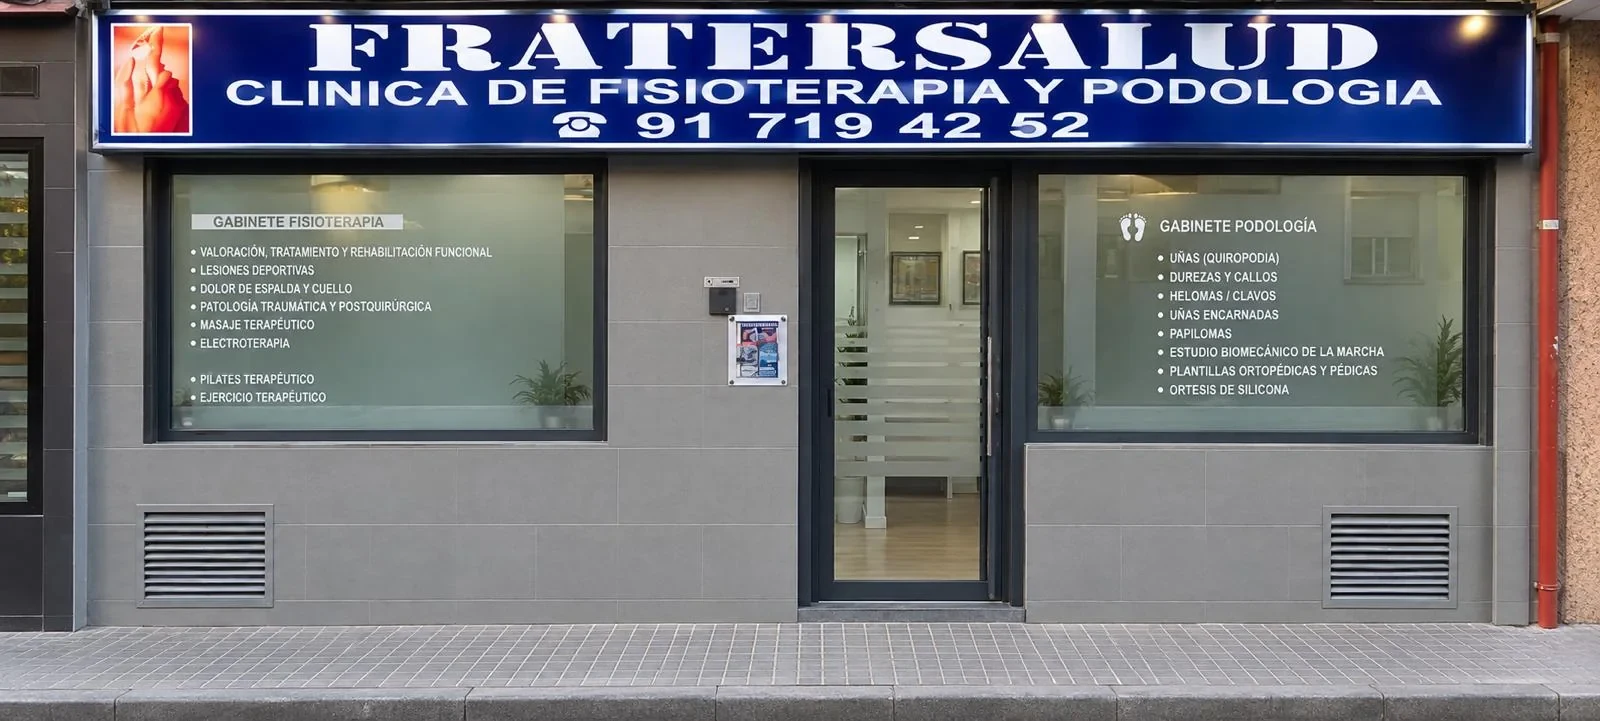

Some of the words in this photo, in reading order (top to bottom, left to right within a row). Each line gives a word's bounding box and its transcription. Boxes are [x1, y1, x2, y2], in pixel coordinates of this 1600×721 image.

[308, 22, 1379, 71] FRATERSALUD
[226, 79, 469, 107] CLINICA
[488, 78, 567, 106] DE
[590, 78, 1010, 105] FISIOTERAPIA
[1023, 78, 1064, 104] Y
[1083, 77, 1442, 106] PODOLOGIA
[636, 112, 711, 139] 91
[748, 112, 873, 139] 719
[898, 112, 982, 139] 42
[1009, 111, 1090, 139] 52
[213, 215, 285, 229] GABINETE
[289, 215, 384, 229] FISIOTERAPIA
[1159, 219, 1232, 233] GABINETE
[1234, 216, 1318, 233] PODOLOGÍA
[200, 244, 268, 259] VALORACIÓN,
[269, 246, 340, 258] TRATAMIENTO
[341, 246, 349, 258] Y
[350, 244, 433, 258] REHABILITACIÓN
[434, 246, 493, 258] FUNCIONAL
[1169, 250, 1201, 264] UÑAS
[1202, 251, 1280, 266] (QUIROPODIA)
[200, 264, 250, 276] LESIONES
[252, 264, 315, 276] DEPORTIVAS
[1169, 271, 1222, 283] DUREZAS
[1223, 271, 1232, 283] Y
[1233, 271, 1278, 283] CALLOS
[200, 283, 236, 295] DOLOR
[238, 283, 253, 294] DE
[254, 283, 301, 295] ESPALDA
[302, 283, 310, 294] Y
[311, 283, 353, 295] CUELLO
[1169, 290, 1224, 302] HELOMAS
[1225, 290, 1231, 302] /
[1232, 290, 1277, 302] CLAVOS
[200, 299, 259, 312] PATOLOGÍA
[260, 299, 328, 312] TRAUMÁTICA
[329, 300, 337, 312] Y
[338, 299, 433, 313] POSTQUIRÚRGICA
[1169, 307, 1201, 321] UÑAS
[1203, 309, 1279, 321] ENCARNADAS
[200, 319, 242, 331] MASAJE
[243, 316, 315, 331] TERAPÉUTICO
[1169, 327, 1233, 340] PAPILOMAS
[200, 337, 291, 349] ELECTROTERAPIA
[1169, 346, 1219, 358] ESTUDIO
[1220, 343, 1299, 358] BIOMECÁNICO
[1301, 346, 1317, 357] DE
[1319, 346, 1335, 357] LA
[1336, 345, 1385, 357] MARCHA
[1169, 365, 1236, 377] PLANTILLAS
[1238, 363, 1317, 377] ORTOPÉDICAS
[1319, 365, 1328, 376] Y
[1329, 363, 1378, 376] PÉDICAS
[200, 374, 242, 385] PILATES
[243, 371, 315, 385] TERAPÉUTICO
[200, 391, 254, 403] EJERCICIO
[255, 389, 327, 403] TERAPÉUTICO
[1169, 384, 1217, 396] ORTESIS
[1219, 384, 1235, 396] DE
[1237, 384, 1290, 396] SILICONA
